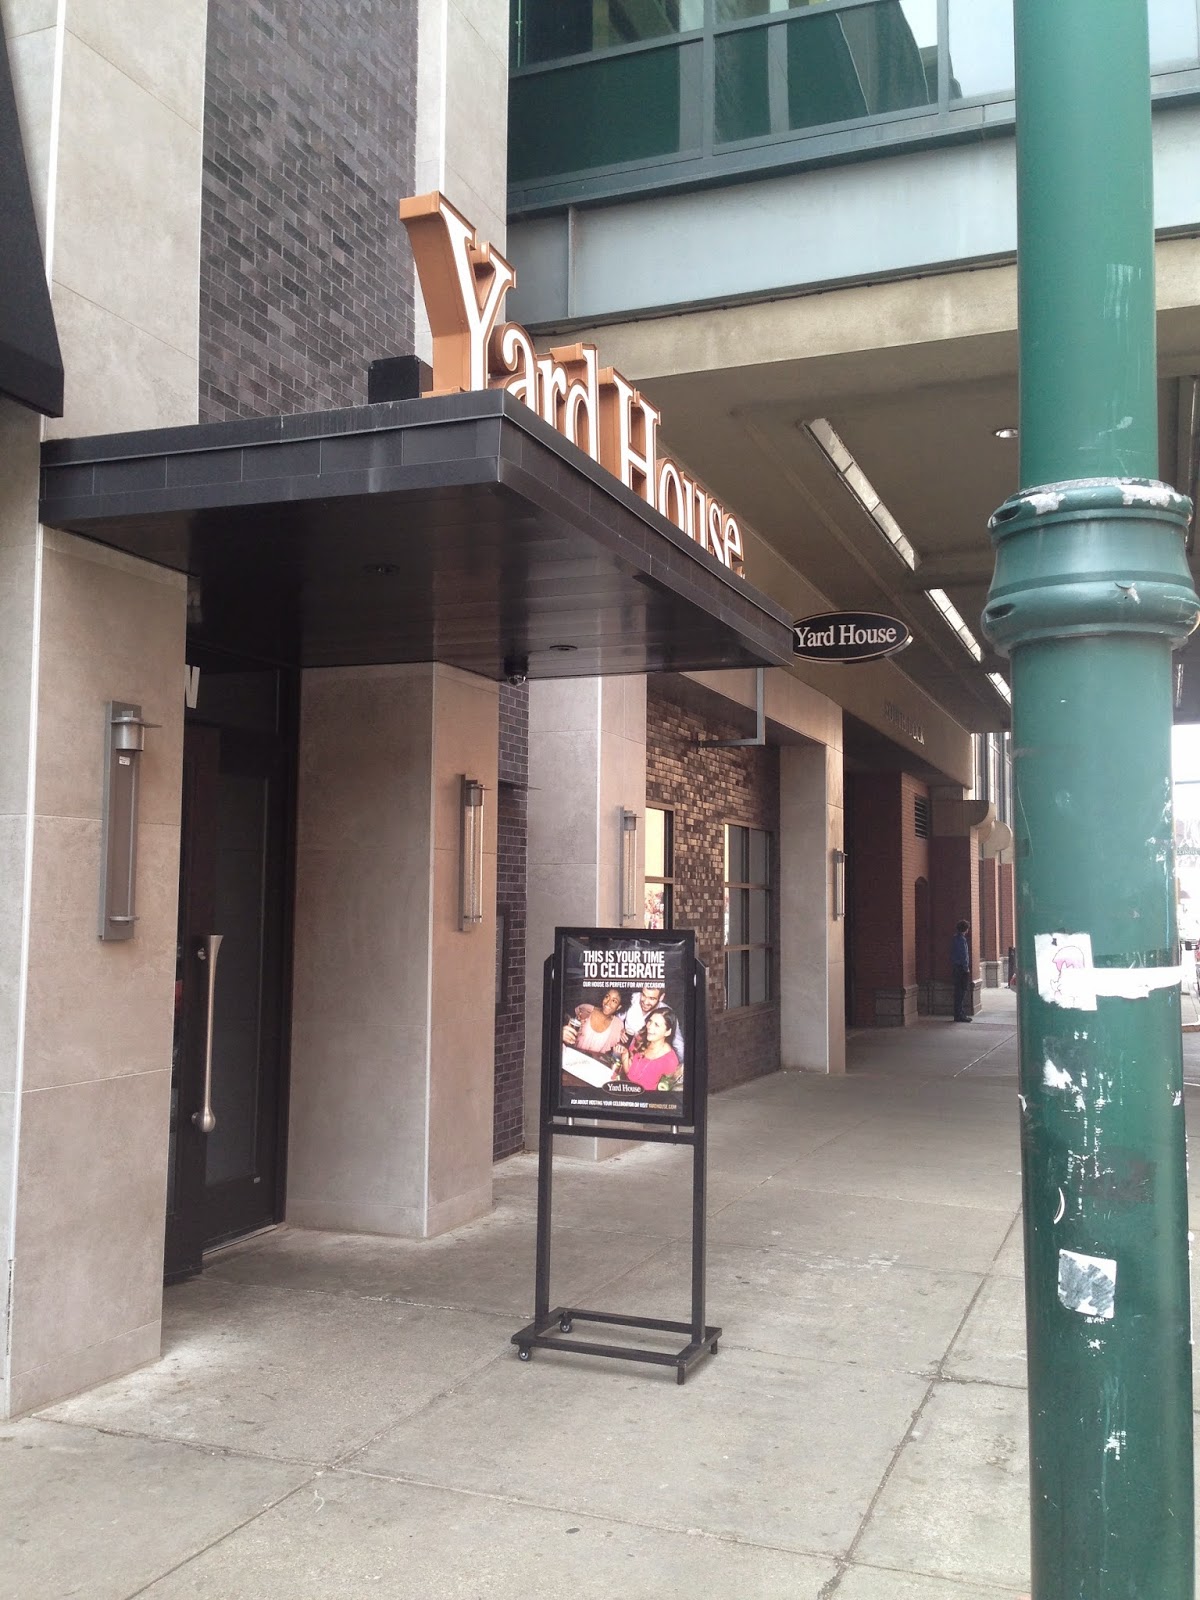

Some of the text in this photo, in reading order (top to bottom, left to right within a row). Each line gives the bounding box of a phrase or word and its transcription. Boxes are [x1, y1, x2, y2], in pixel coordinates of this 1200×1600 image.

[400, 191, 745, 577] Yard House
[794, 624, 897, 648] Yard House
[583, 950, 665, 963] THIS IS YOUR TIME
[583, 963, 665, 979] TO CELEBRATE
[607, 1083, 641, 1093] Yard House
